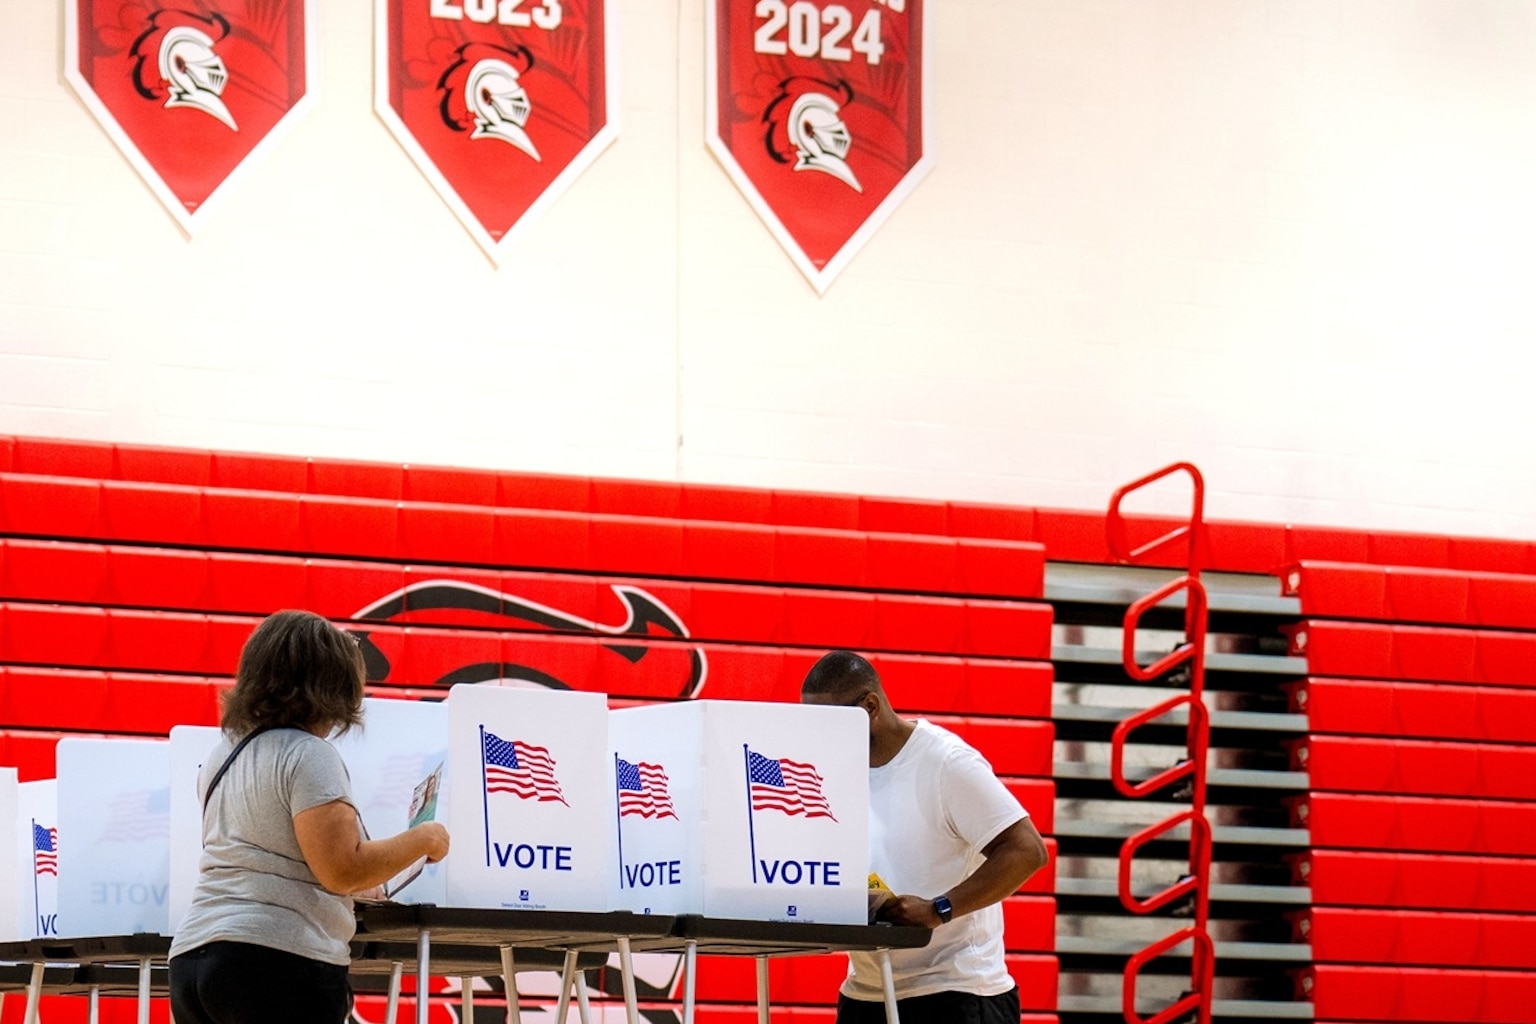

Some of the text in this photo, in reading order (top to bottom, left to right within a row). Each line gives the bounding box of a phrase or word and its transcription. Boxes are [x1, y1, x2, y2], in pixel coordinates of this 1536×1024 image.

[753, 0, 885, 65] 2024
[493, 842, 572, 871] VOTE
[625, 860, 681, 888] VOTE
[759, 859, 841, 886] VOTE
[40, 913, 58, 936] VO
